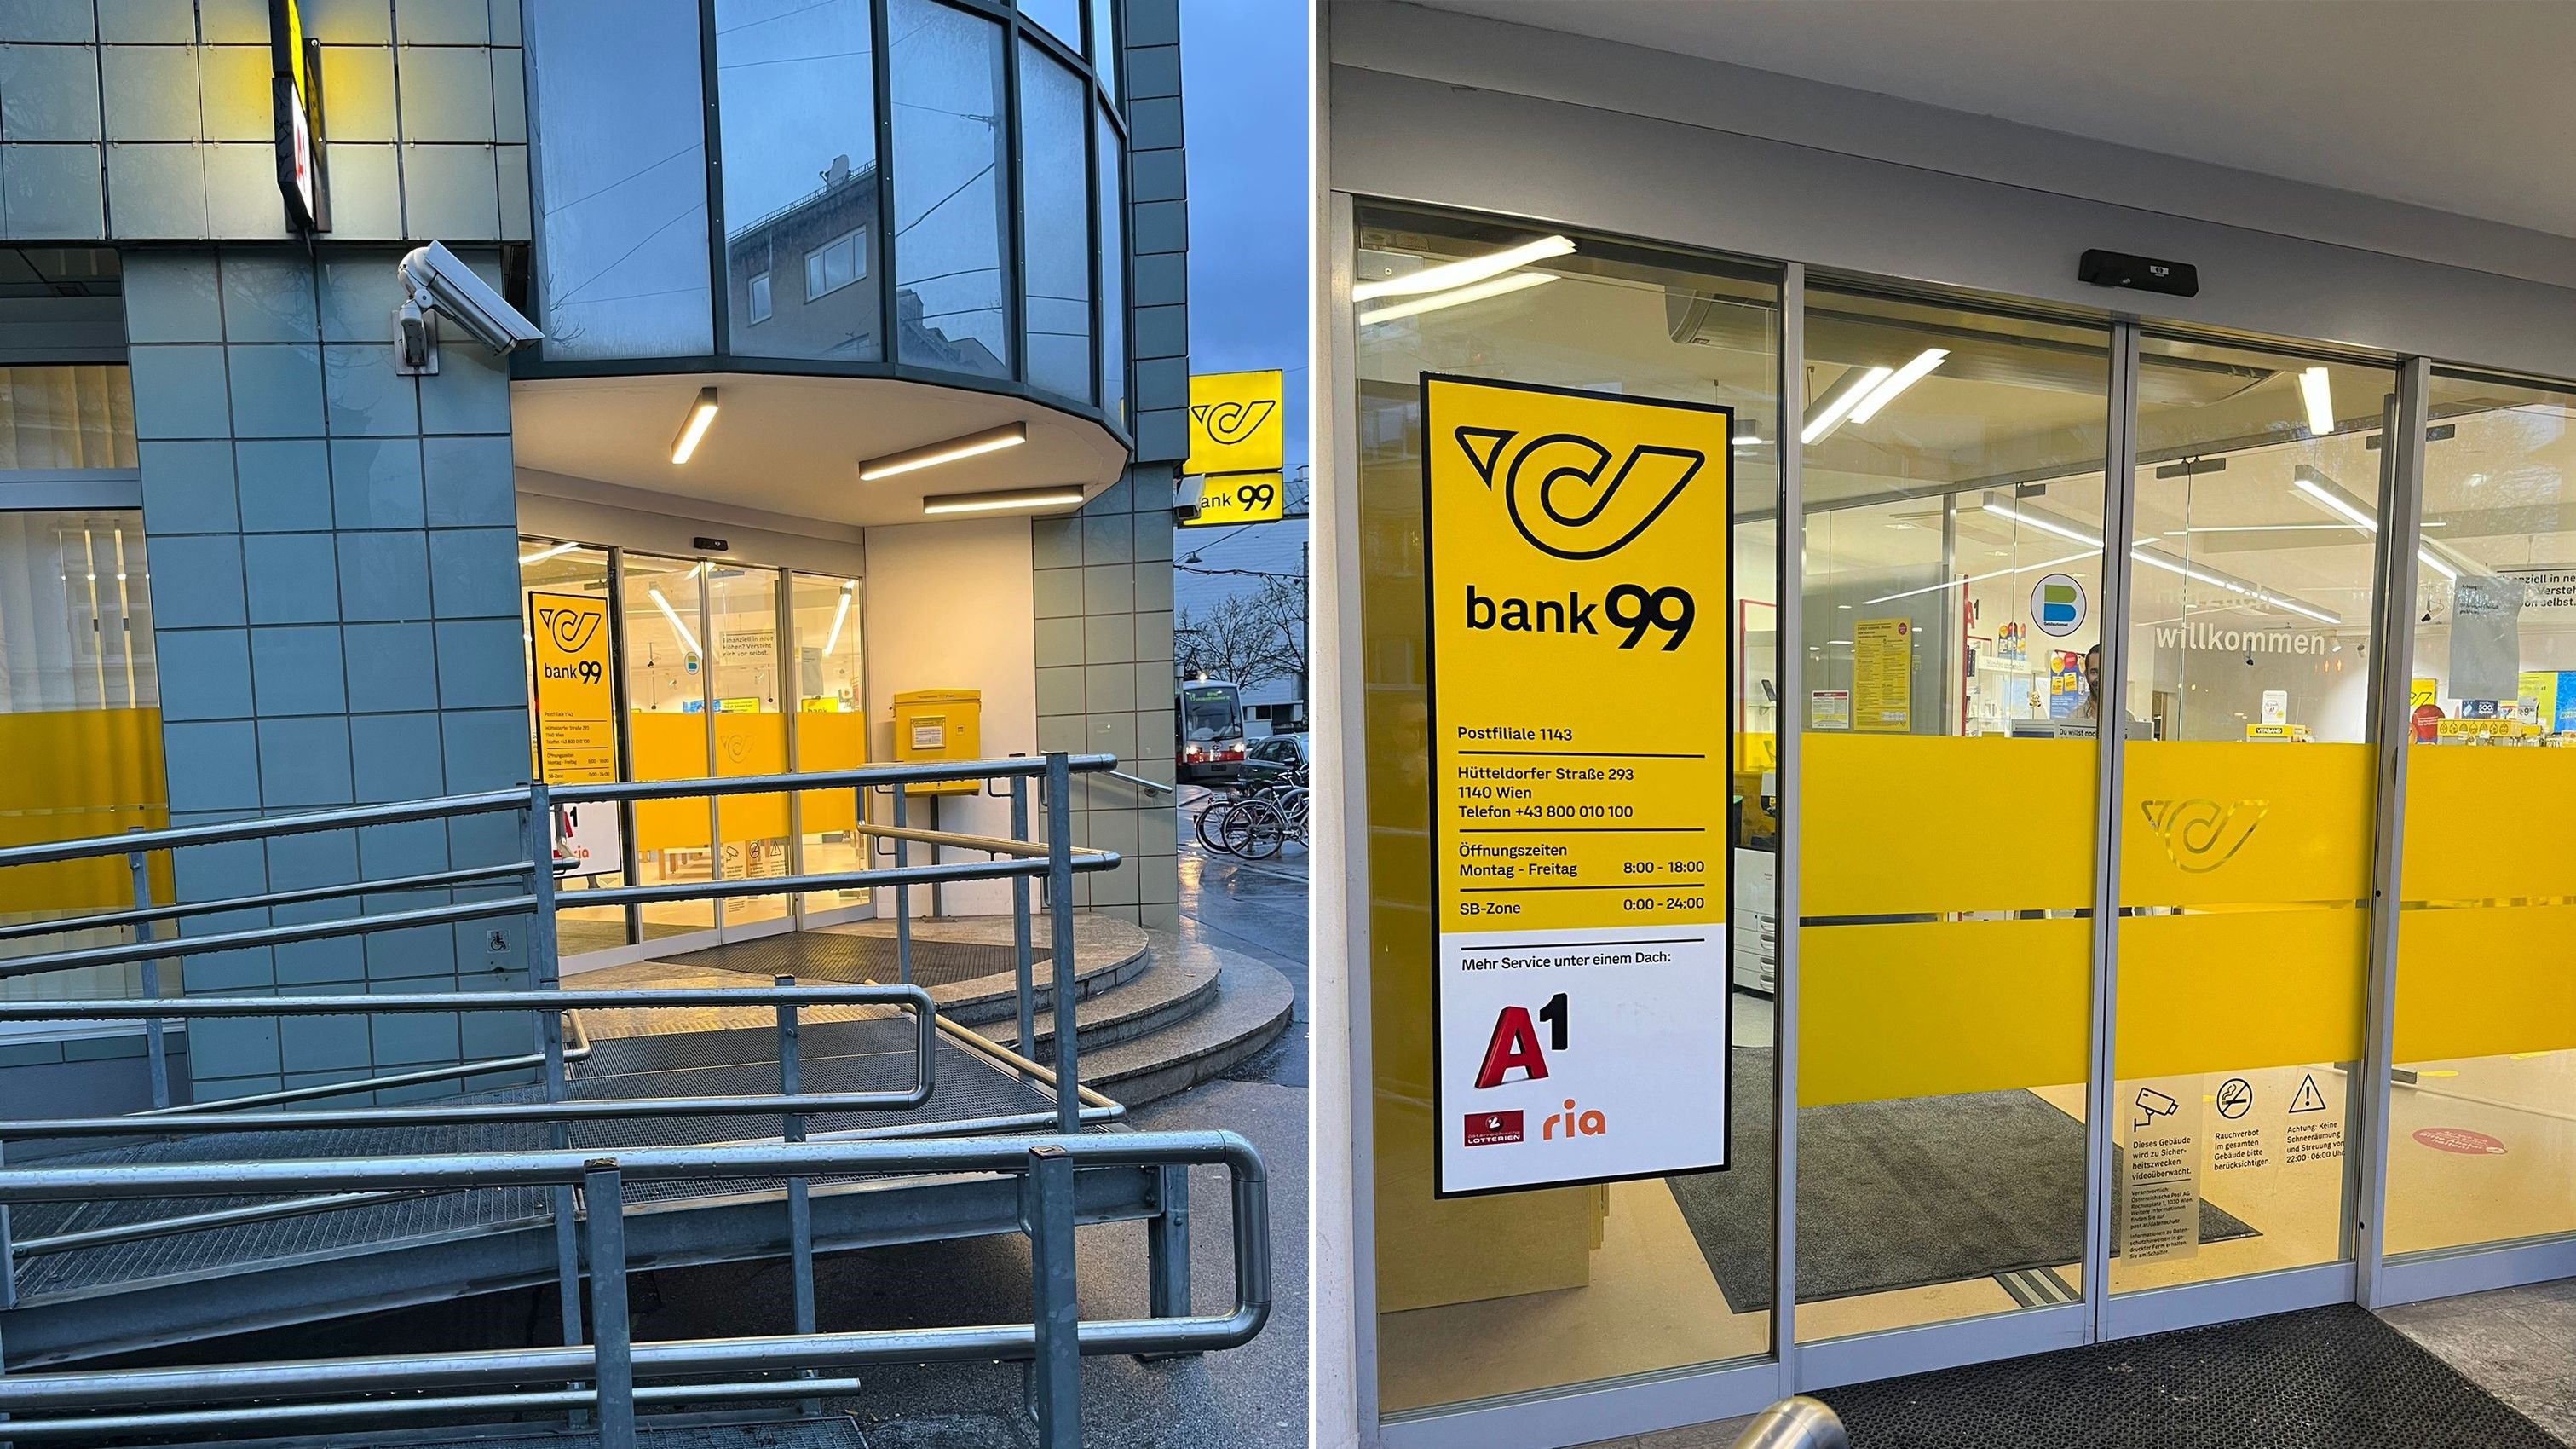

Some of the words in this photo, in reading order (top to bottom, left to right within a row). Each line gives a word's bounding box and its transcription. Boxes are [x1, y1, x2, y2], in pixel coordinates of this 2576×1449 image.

[1201, 493, 1232, 508] ank
[1237, 484, 1274, 511] 99
[2550, 574, 2559, 583] in
[2156, 622, 2325, 655] willkommen
[1458, 726, 1535, 740] Postfiliale
[1540, 728, 1572, 741] 1143
[1458, 767, 1551, 780] Hütteldorfer
[1556, 767, 1604, 780] Straße
[1608, 768, 1634, 781] 293
[1458, 787, 1492, 799] 1140
[1496, 786, 1532, 799] Wien
[1458, 806, 1511, 818] Telefon
[1515, 806, 1542, 818] +43
[1546, 806, 1575, 818] 800
[1579, 806, 1604, 818] 010
[1610, 806, 1633, 818] 100
[1459, 842, 1567, 860] Öffnungszeiten
[1459, 864, 1514, 878] Montag
[1528, 863, 1578, 877] Freitag
[1623, 862, 1654, 874] 8:00
[1668, 861, 1705, 873] 18:00
[1460, 903, 1521, 915] SB-Zone
[1623, 899, 1654, 911] 0:00
[1666, 897, 1705, 909] 24:00
[1462, 958, 1498, 971] Mehr
[1501, 956, 1551, 969] Service
[1554, 955, 1590, 967] unter
[1593, 954, 1632, 965] einem
[1635, 951, 1671, 964] Dach:
[1474, 993, 1567, 1089] A1
[1543, 1099, 1605, 1141] ria
[2215, 1129, 2259, 1140] Rauchverbot
[2287, 1125, 2317, 1133] Achtung:
[1468, 1135, 1520, 1144] LOTTERIEN
[2159, 1137, 2191, 1146] Gebäude
[2287, 1131, 2340, 1143] Schneeräumung
[2225, 1140, 2259, 1151] gesamten
[2301, 1142, 2332, 1151] Streuung
[2161, 1148, 2186, 1156] Sicher-
[2215, 1151, 2245, 1160] Gebäude
[2287, 1154, 2306, 1163] 22:00
[2311, 1152, 2331, 1160] 06:00
[2132, 1159, 2181, 1169] heitszwecken
[2214, 1159, 2271, 1171] berücksichtigen.
[2132, 1168, 2191, 1180] videoüberwacht.
